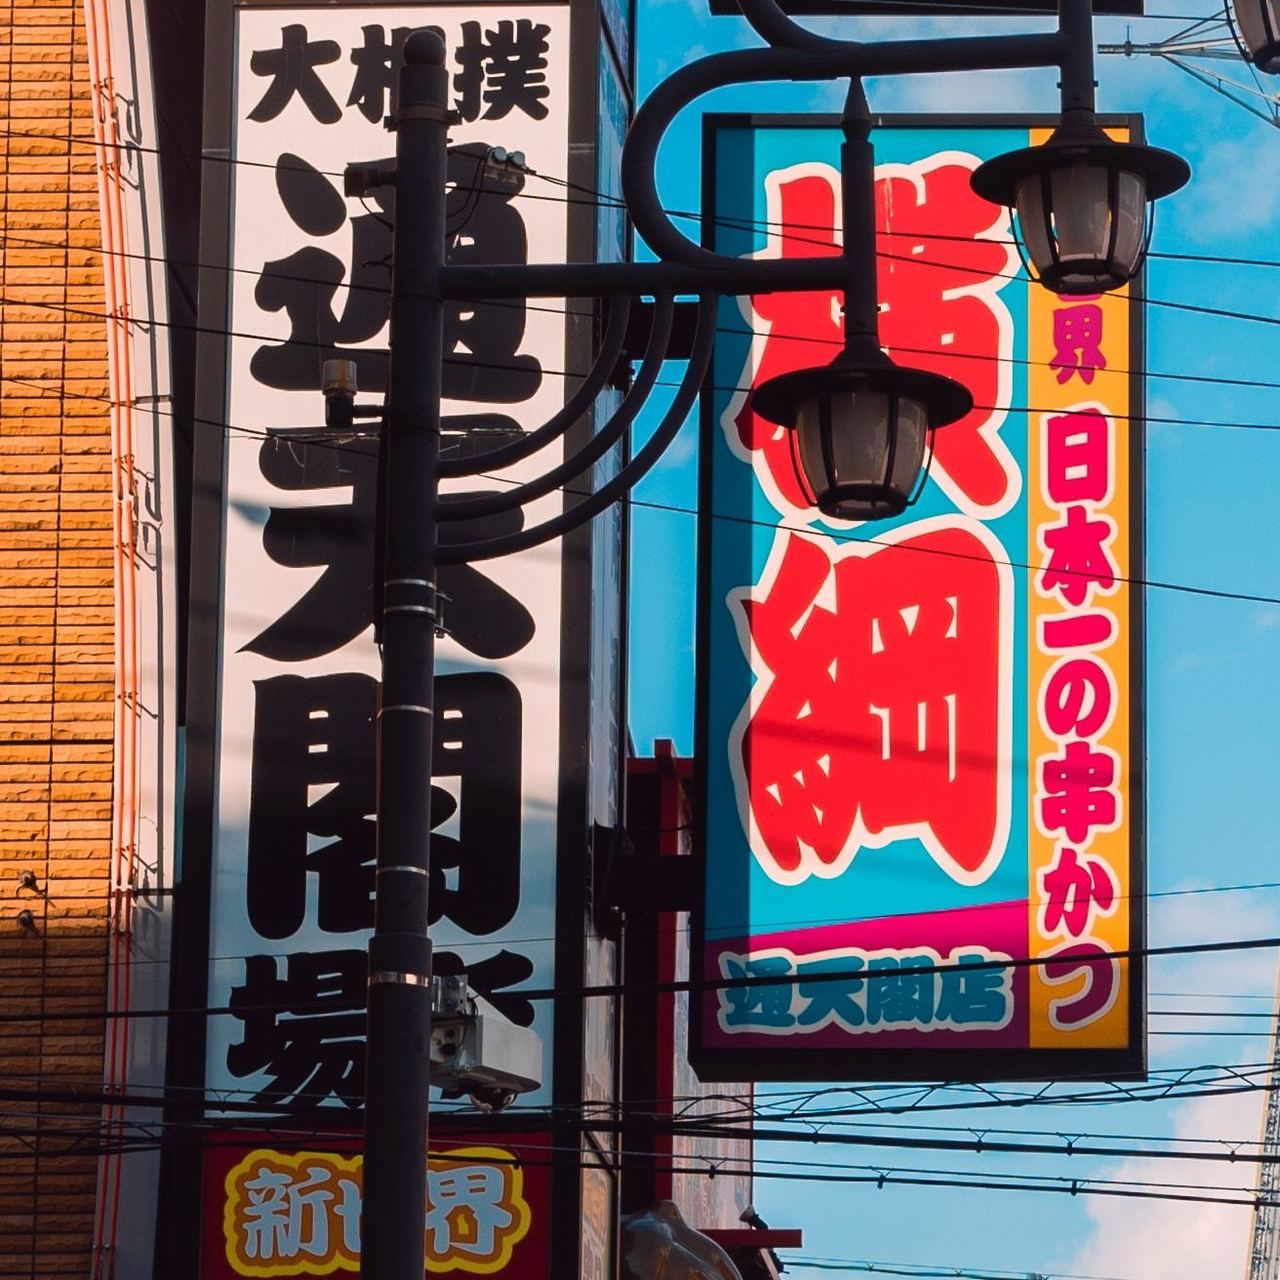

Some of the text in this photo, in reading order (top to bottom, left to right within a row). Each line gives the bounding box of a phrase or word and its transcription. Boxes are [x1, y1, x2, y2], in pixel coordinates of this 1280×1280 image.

[1042, 404, 1122, 1027] 日本一の串かつ
[721, 947, 1014, 1031] 通天閣店
